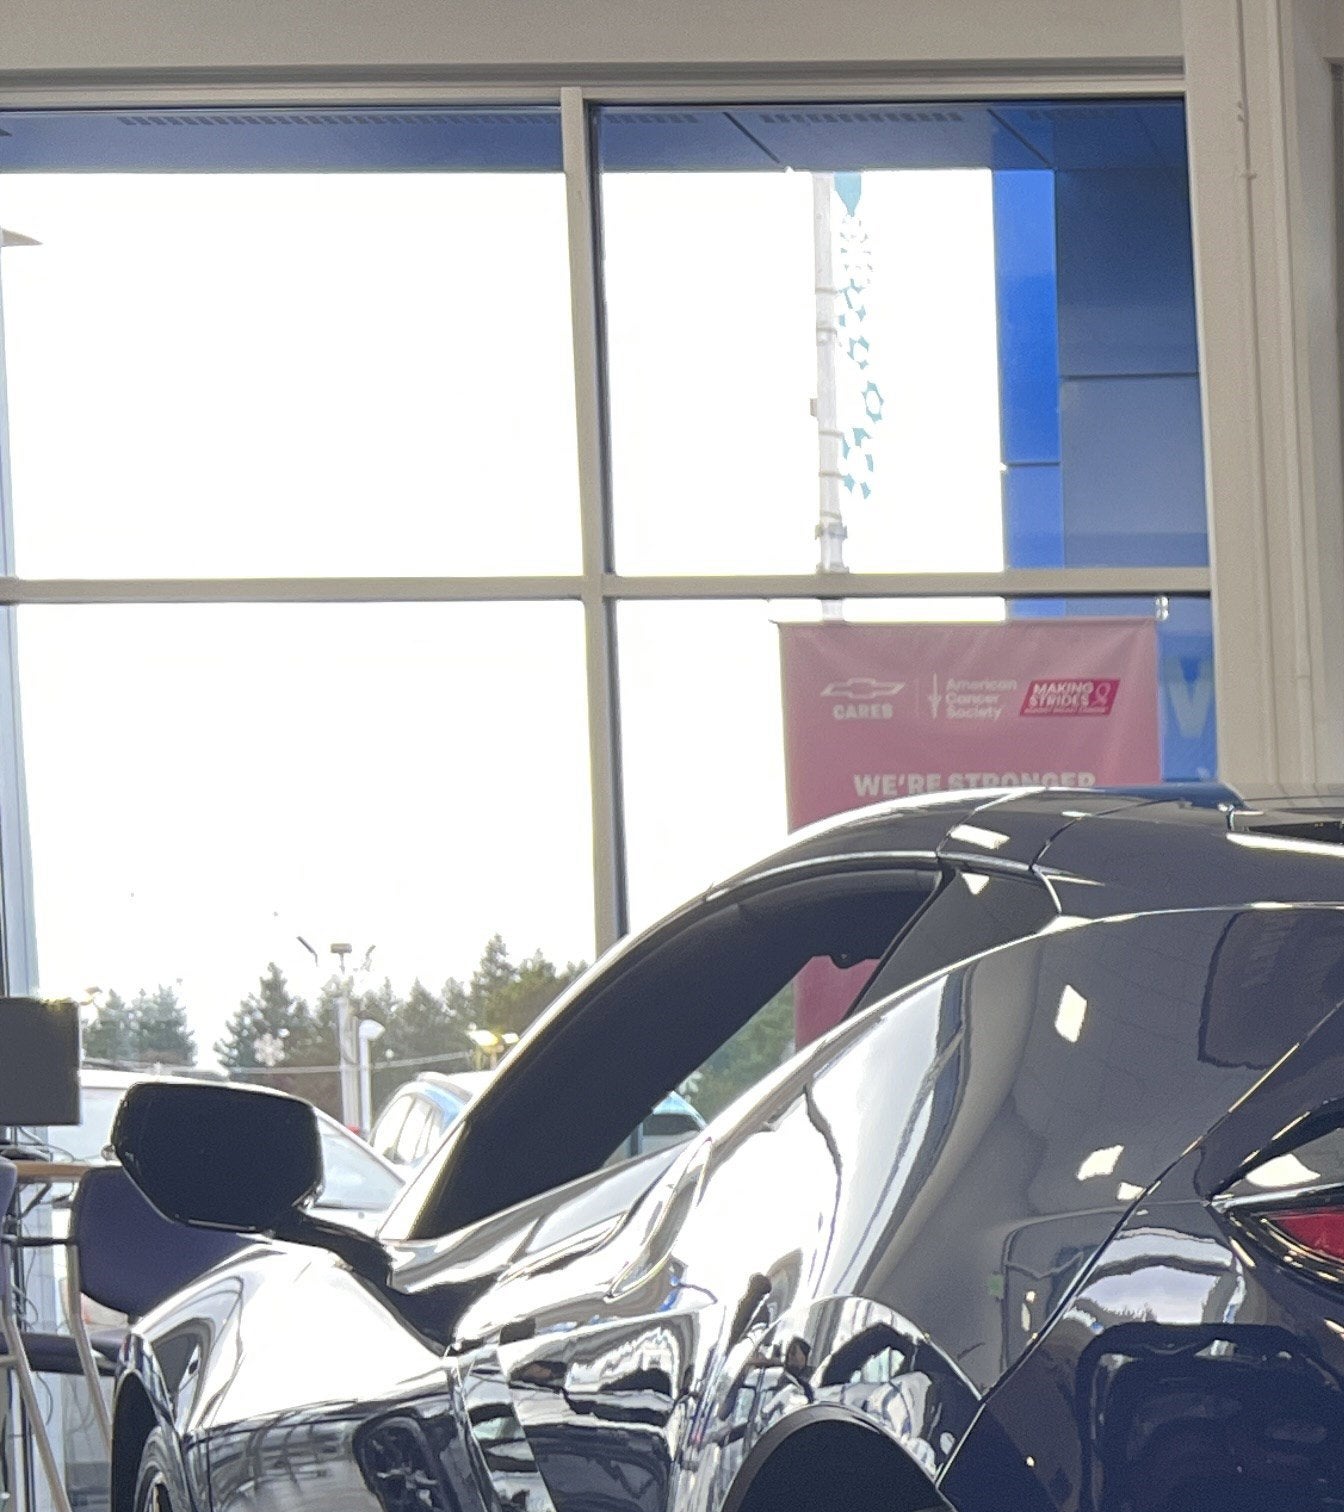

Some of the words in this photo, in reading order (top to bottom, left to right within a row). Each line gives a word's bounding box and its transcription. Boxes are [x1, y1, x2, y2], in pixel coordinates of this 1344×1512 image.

[1033, 681, 1094, 694] MAKING
[832, 703, 893, 720] CARES
[853, 773, 941, 797] WE'RE
